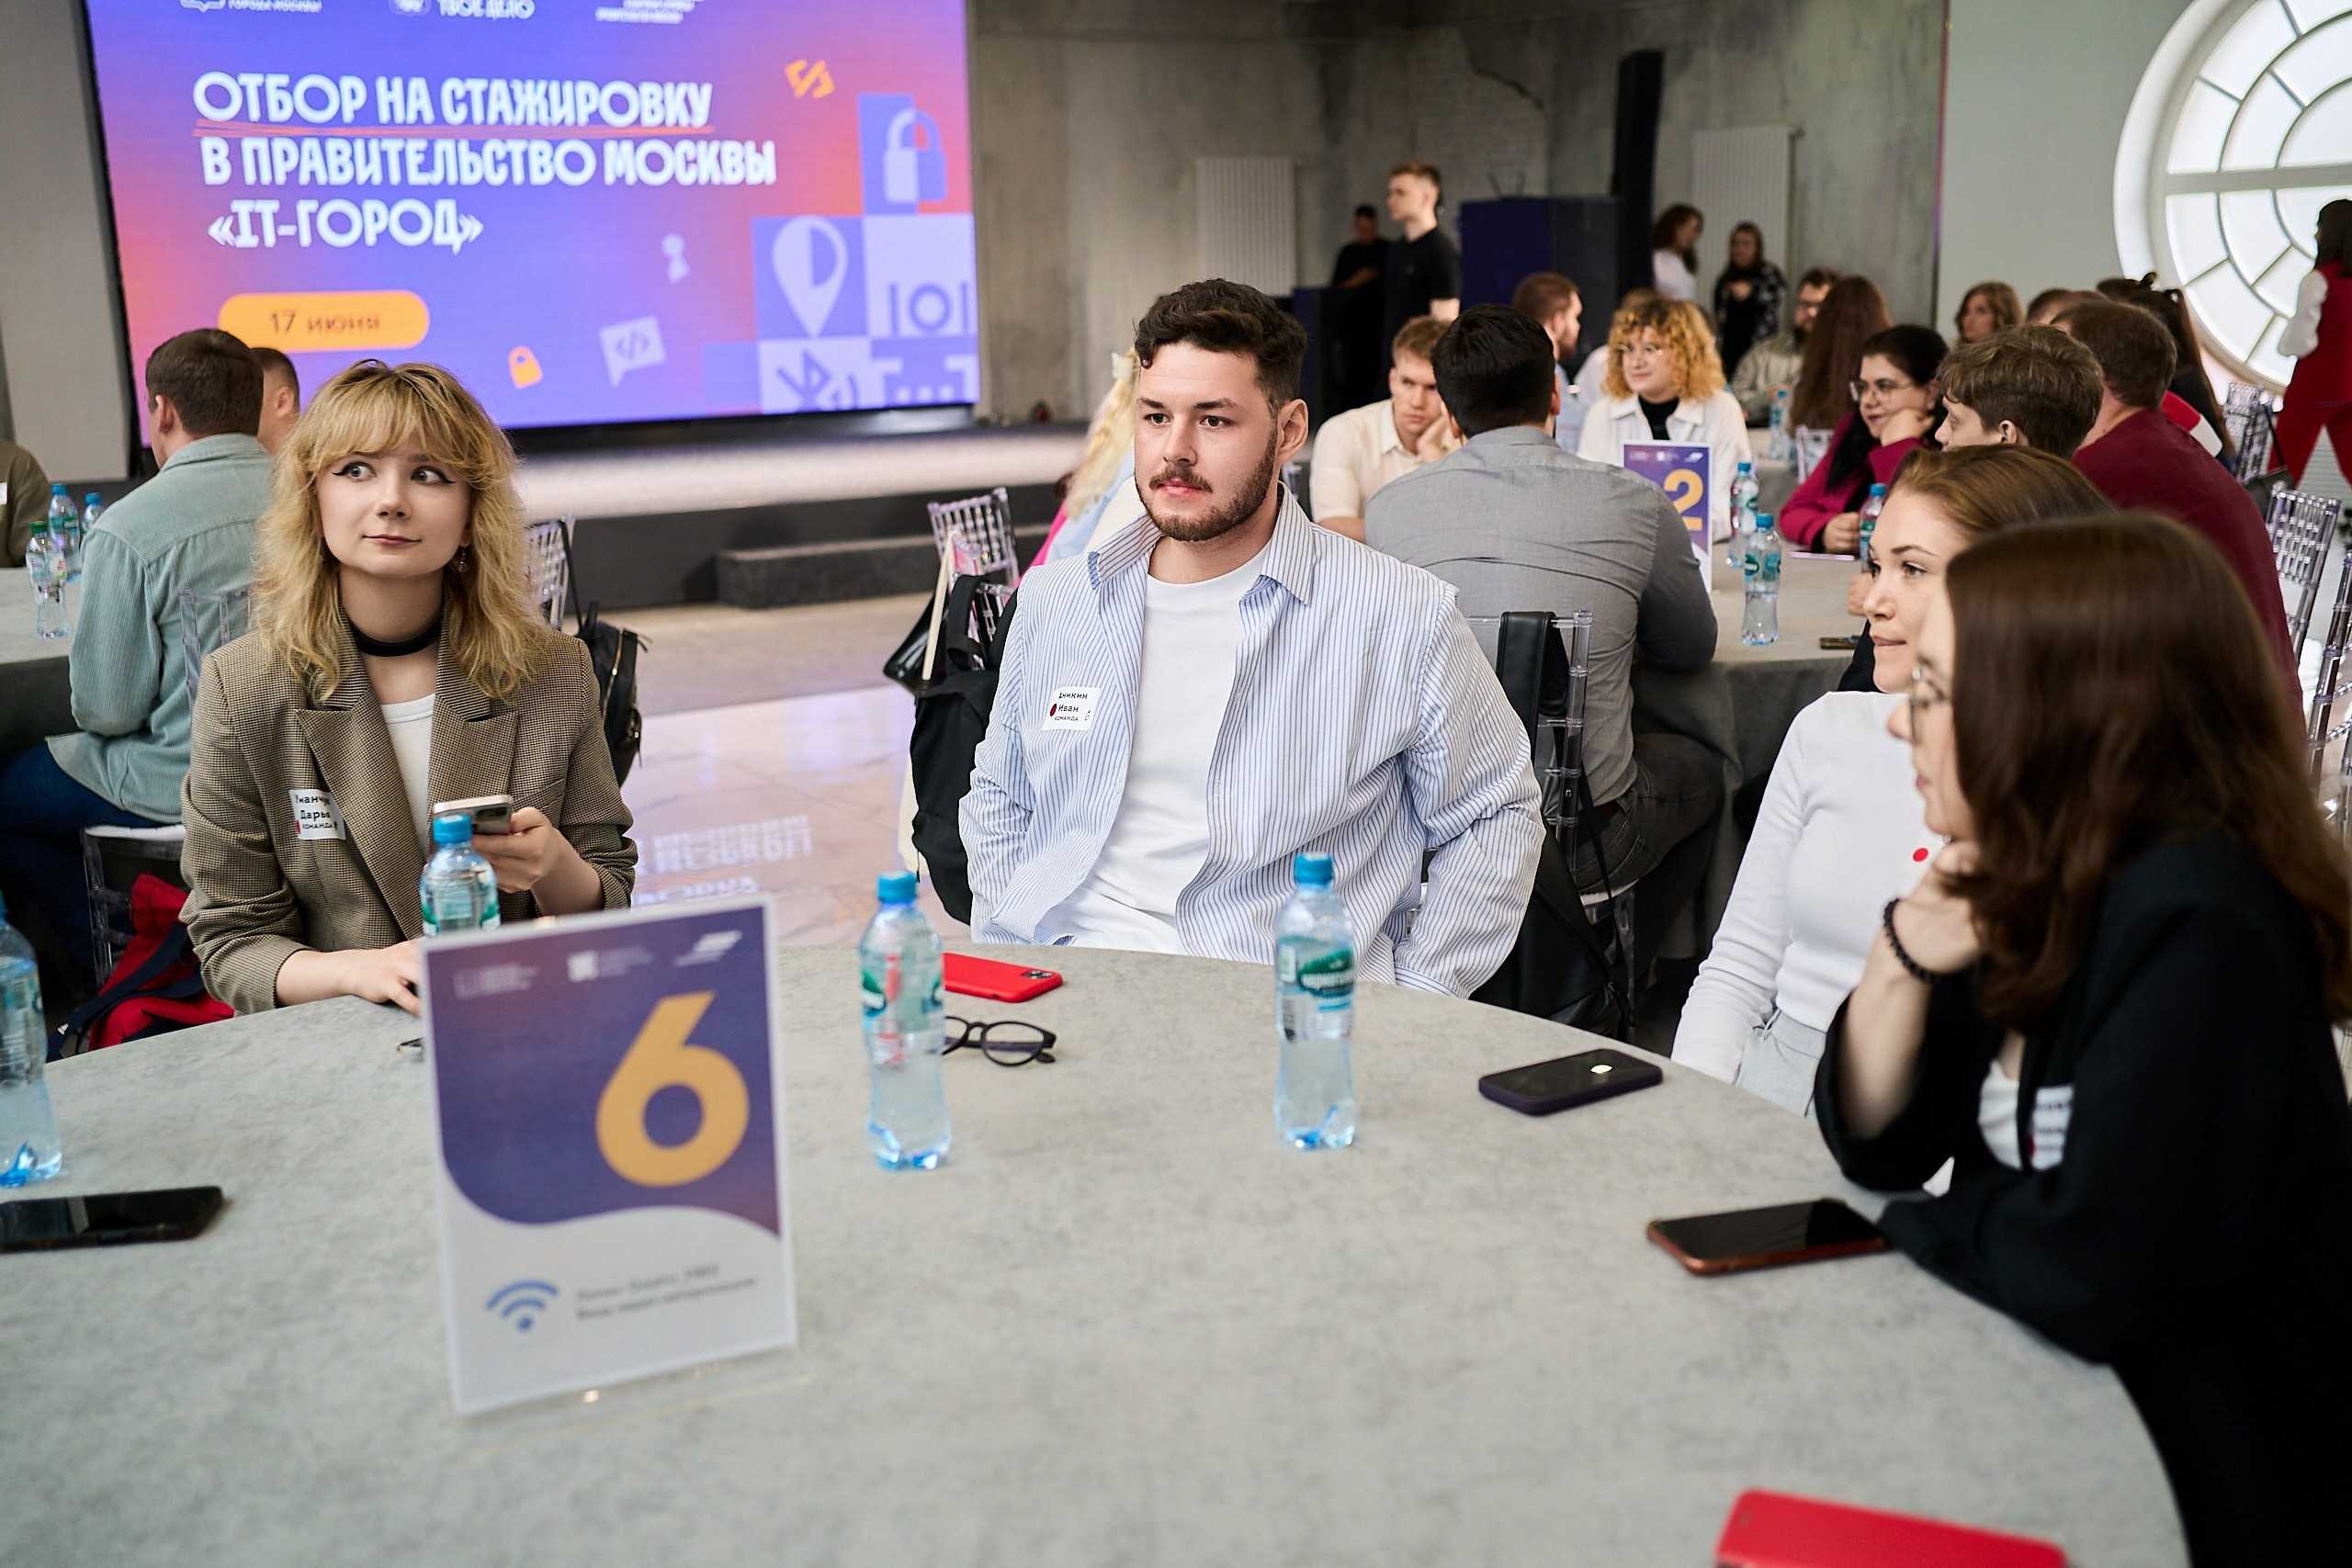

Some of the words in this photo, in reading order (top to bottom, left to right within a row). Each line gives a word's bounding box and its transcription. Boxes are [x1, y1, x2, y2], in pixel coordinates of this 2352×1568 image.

[193, 71, 368, 124] ОТБОР
[375, 75, 435, 126] НА
[440, 77, 713, 129] СТАЖИРОВКУ
[200, 137, 233, 186] В
[241, 137, 597, 187] ПРАВИТЕЛЬСТВО
[603, 140, 778, 186] МОСКВЫ
[208, 199, 484, 254] «IT-ГОРОД»
[268, 310, 298, 336] 17
[306, 310, 381, 336] июня
[1664, 468, 1703, 531] 2
[595, 990, 750, 1188] 6
